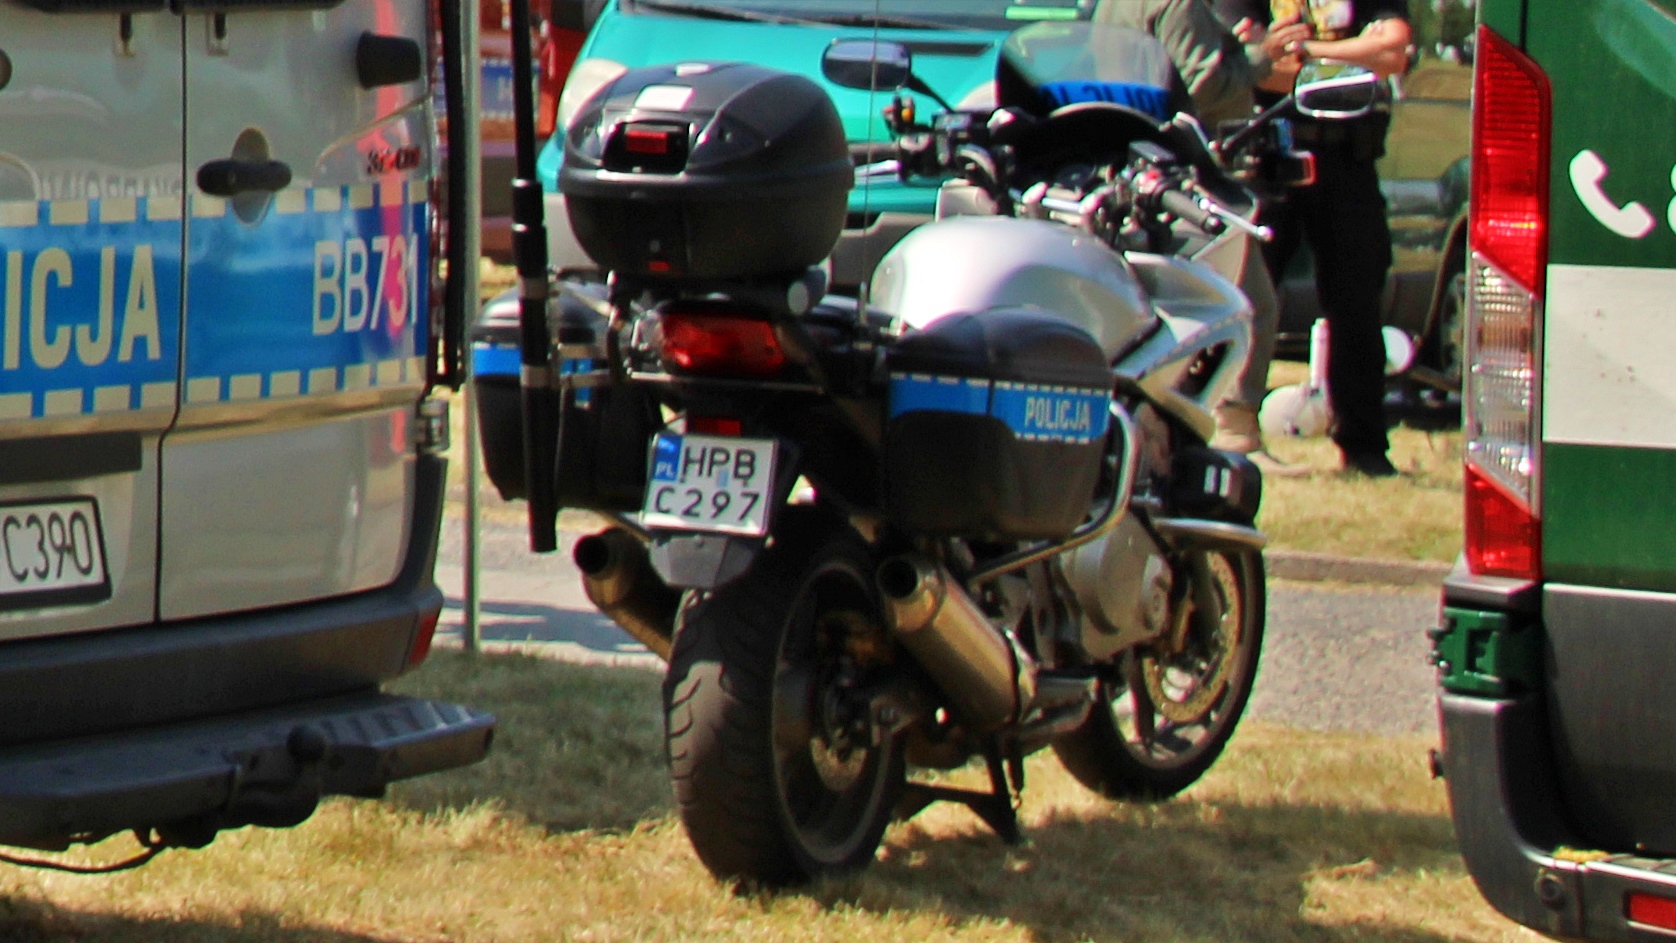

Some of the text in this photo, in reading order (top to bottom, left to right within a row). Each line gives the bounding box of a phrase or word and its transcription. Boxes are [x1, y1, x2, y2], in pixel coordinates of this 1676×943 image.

[3, 245, 161, 370] ICJA
[313, 232, 418, 335] BB731
[1024, 397, 1091, 432] POLICJA
[681, 446, 757, 481] HPB
[654, 485, 760, 521] C297
[3, 510, 94, 582] C390
